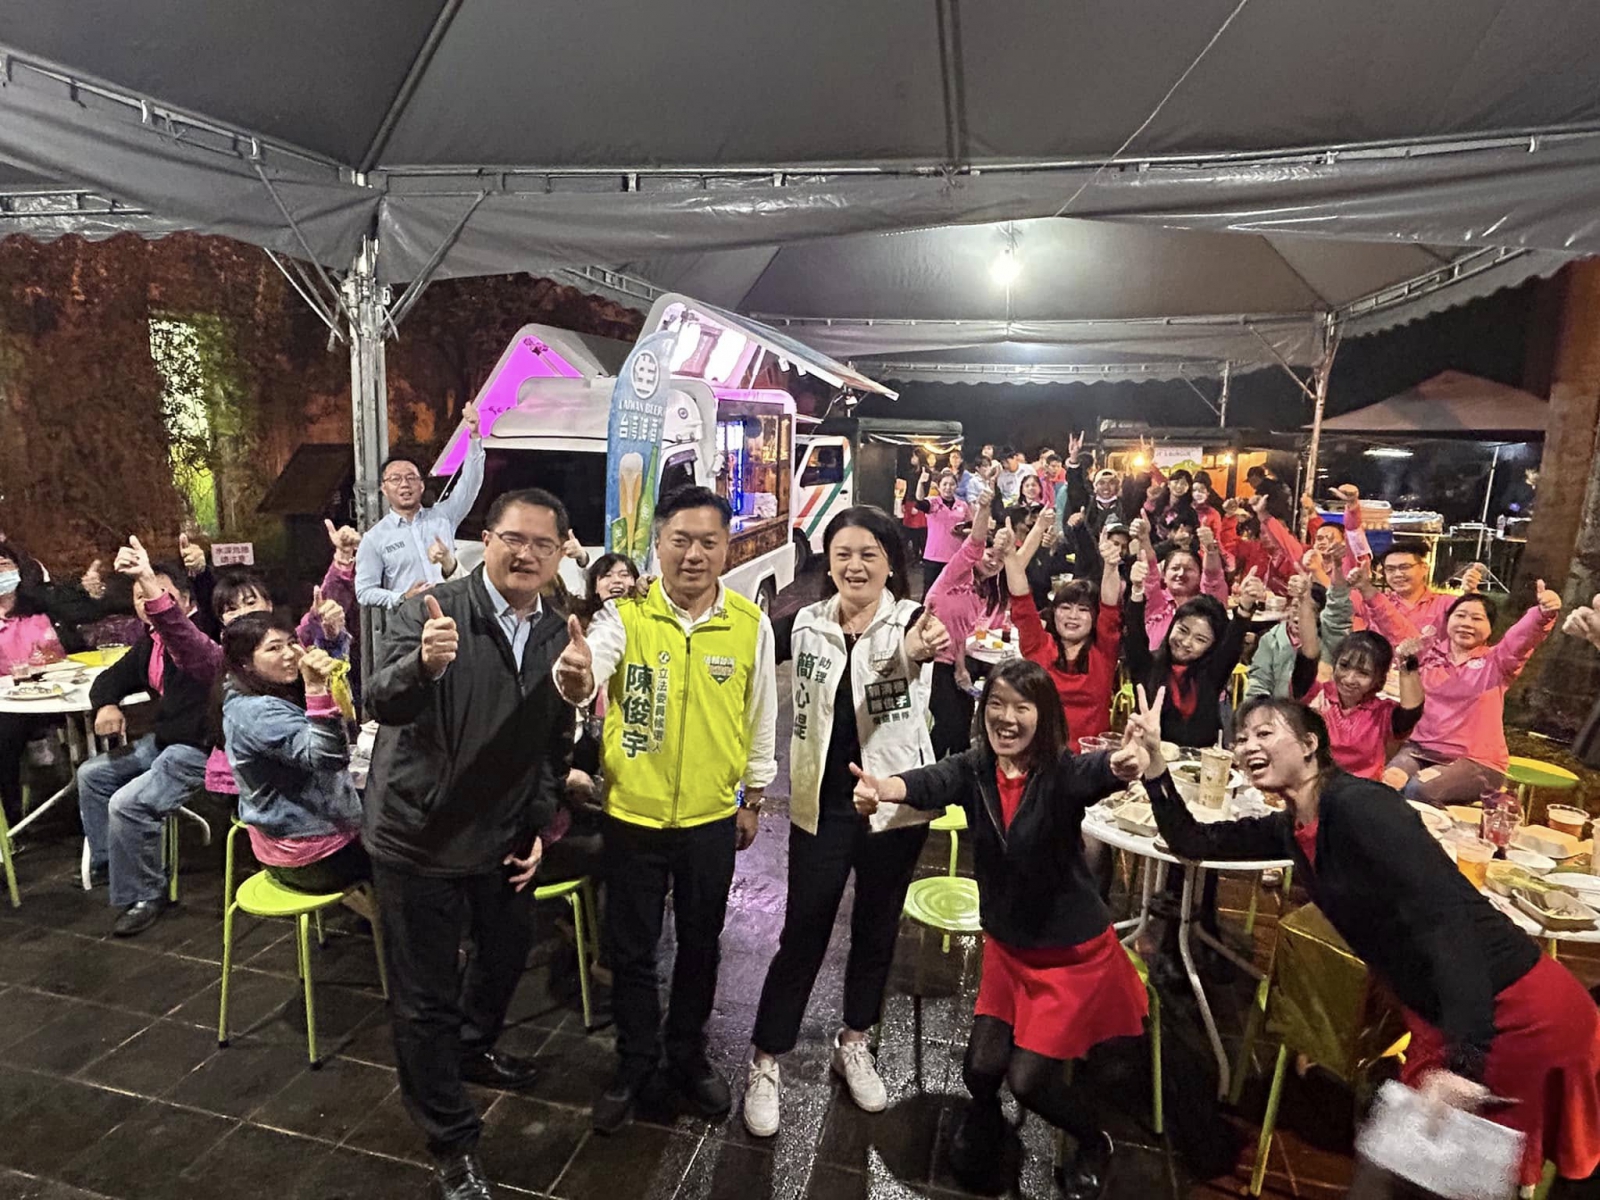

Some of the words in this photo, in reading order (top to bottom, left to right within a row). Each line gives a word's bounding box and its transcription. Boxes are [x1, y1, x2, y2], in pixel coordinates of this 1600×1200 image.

[619, 400, 643, 412] TAIWAN
[645, 403, 663, 416] BEER
[815, 656, 832, 684] 助理
[622, 664, 652, 758] 陳俊宇
